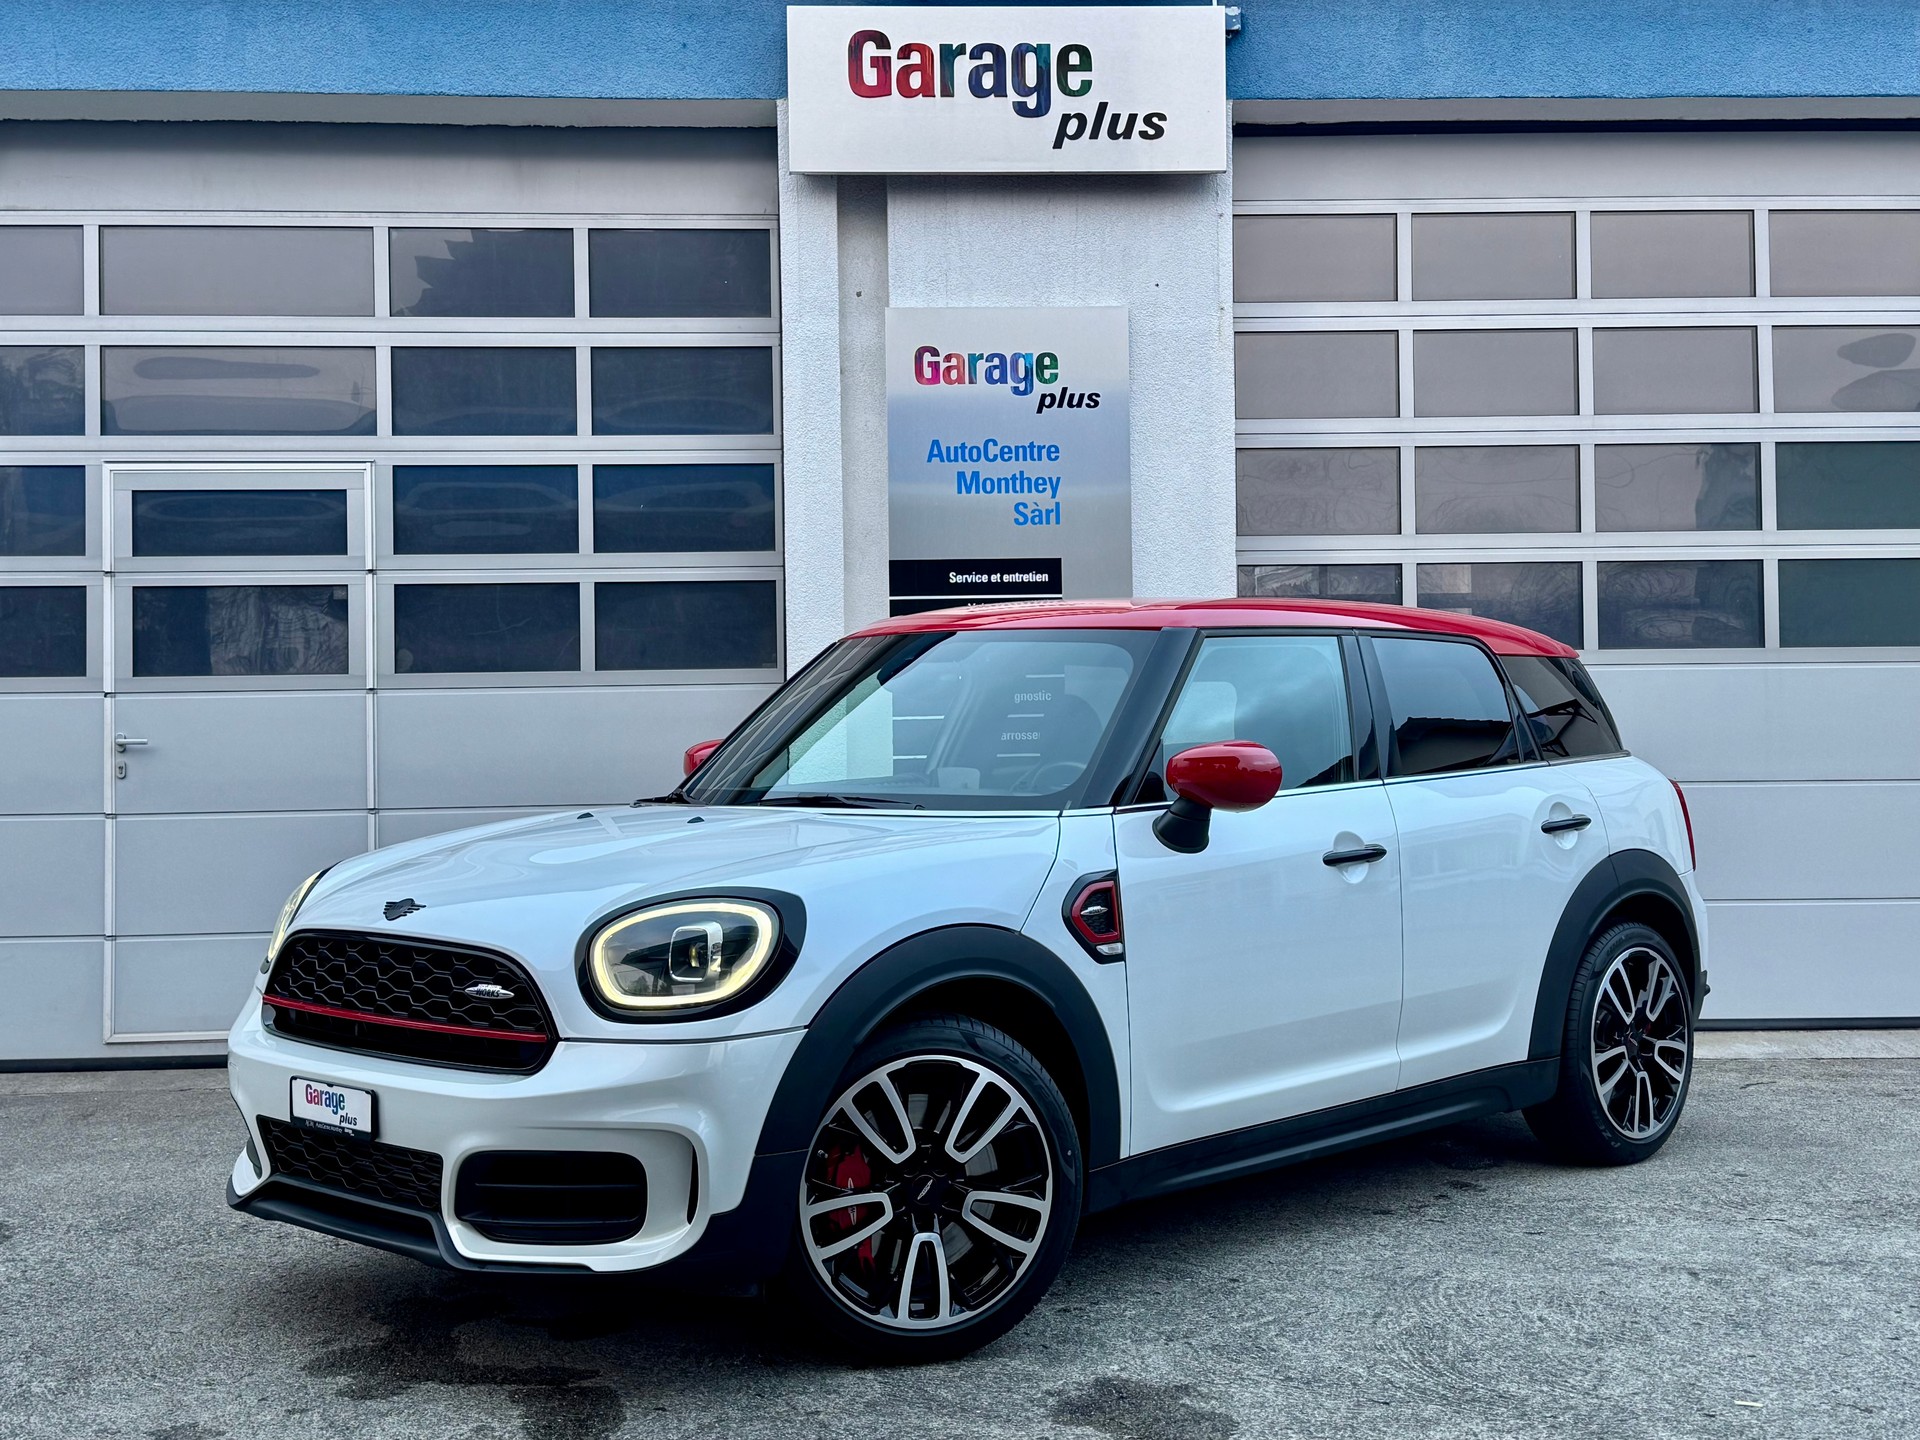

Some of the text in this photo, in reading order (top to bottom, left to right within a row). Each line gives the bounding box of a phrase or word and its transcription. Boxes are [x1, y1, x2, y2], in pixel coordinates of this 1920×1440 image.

[847, 29, 1093, 118] Garage
[1052, 101, 1168, 149] plus
[914, 345, 1059, 396] Garage
[1036, 387, 1100, 414] plus
[927, 439, 1059, 463] AutoCentre
[956, 471, 1061, 499] Monthey
[1013, 502, 1061, 526] Sàrl
[949, 571, 1048, 583] Service et entretien
[1015, 690, 1052, 703] gnostic
[305, 1083, 345, 1115] Garage
[339, 1112, 358, 1126] plus
